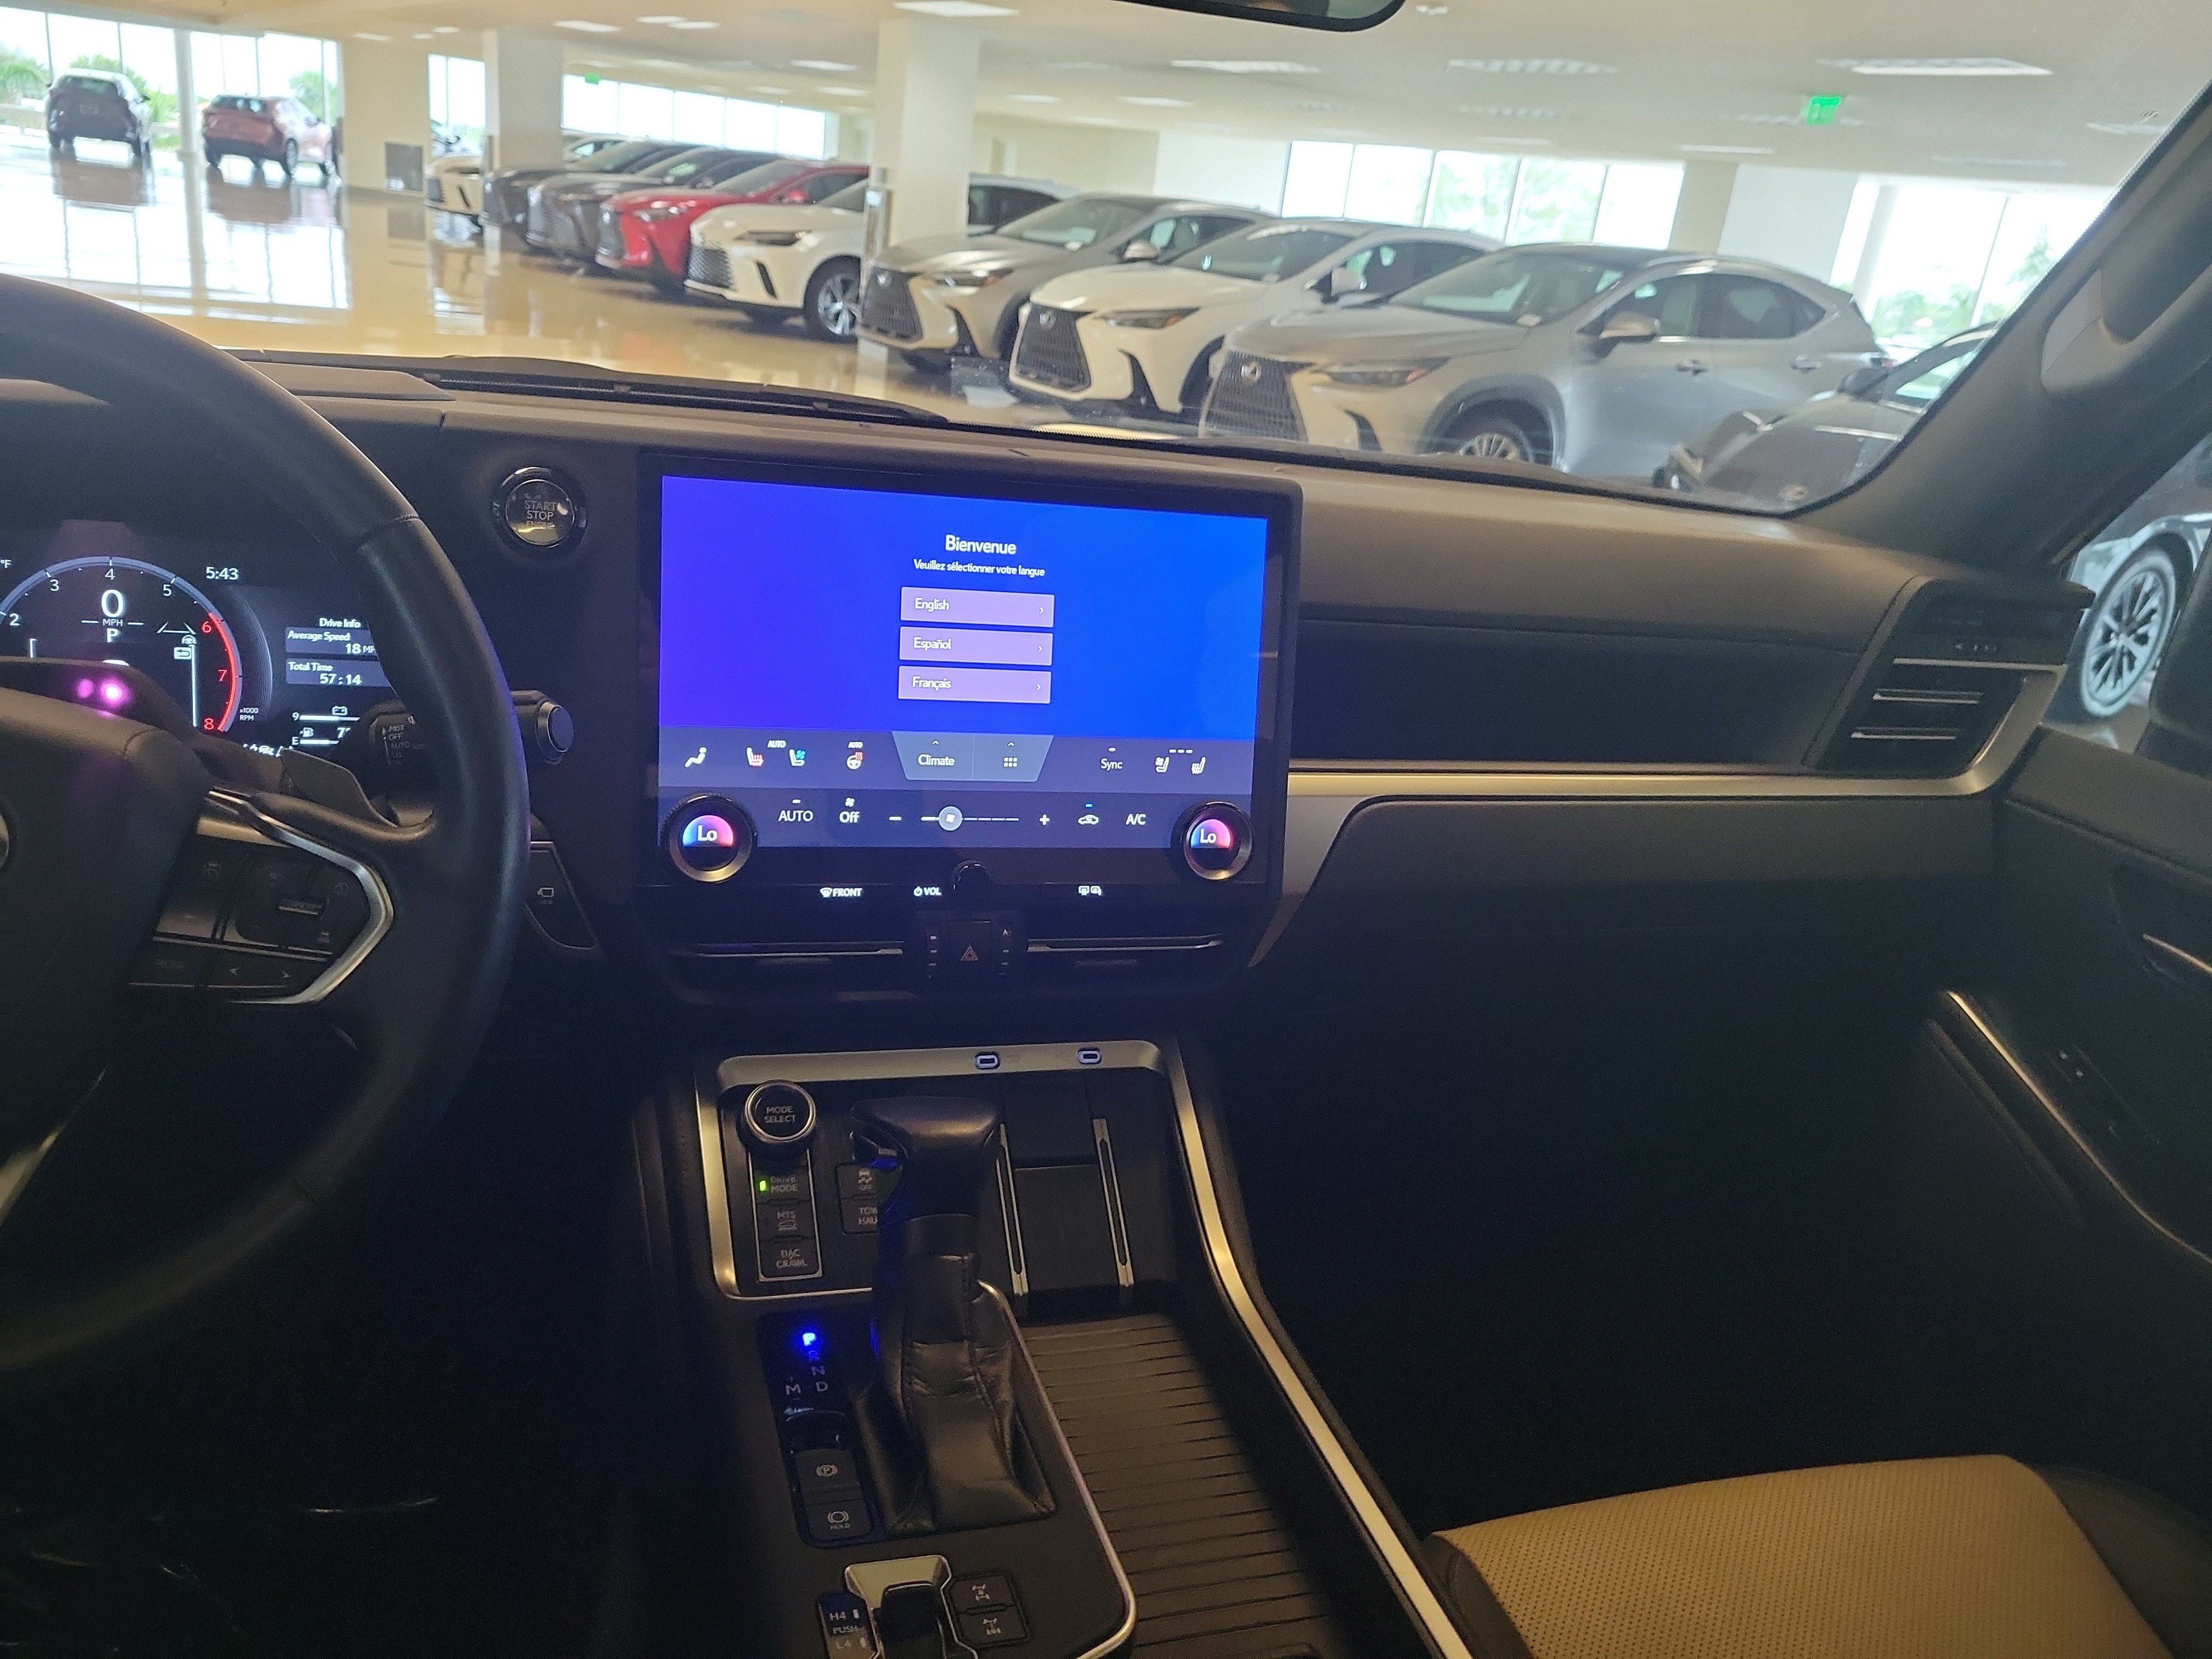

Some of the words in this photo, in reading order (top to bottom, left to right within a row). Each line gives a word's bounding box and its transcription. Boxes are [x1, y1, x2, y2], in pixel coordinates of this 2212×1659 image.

[524, 500, 557, 512] START
[526, 511, 554, 520] STOP
[945, 534, 1017, 555] Bienvenue
[104, 568, 116, 580] 4
[206, 566, 239, 580] 5:43
[913, 558, 945, 571] Veuillez
[946, 561, 995, 574] sélectionner
[996, 565, 1017, 574] votre
[1018, 565, 1045, 578] langue
[50, 579, 59, 591] 3
[162, 584, 172, 596] 5
[101, 589, 124, 618] 0
[915, 597, 950, 612] English
[9, 613, 20, 626] 2
[103, 618, 123, 627] MPH
[319, 617, 343, 628] Drive
[344, 619, 362, 629] Info
[202, 621, 212, 633] 6
[106, 628, 119, 643] P
[287, 630, 323, 642] Average
[324, 632, 351, 642] Speed
[345, 644, 361, 654] 18
[363, 645, 376, 653] MP
[913, 637, 952, 651] Español
[287, 662, 310, 671] Total
[311, 662, 334, 672] Time
[218, 669, 228, 682] 7
[912, 676, 952, 691] Français
[292, 712, 299, 721] 9
[204, 718, 214, 730] 8
[292, 736, 299, 745] E
[388, 732, 403, 741] OFF
[767, 740, 787, 748] AUTO
[918, 753, 956, 766] Climate
[1101, 758, 1123, 771] Sync
[778, 810, 814, 822] AUTO
[839, 811, 860, 823] Off
[1126, 814, 1146, 825] A/C
[697, 825, 718, 842] Lo
[1199, 828, 1216, 844] Lo
[832, 888, 862, 897] FRONT
[923, 887, 943, 896] VOL
[766, 1105, 794, 1114] MODE
[764, 1114, 795, 1123] SELECT
[770, 1184, 798, 1193] MODE
[777, 1211, 796, 1219] MTS
[859, 1216, 878, 1226] HAU
[781, 1249, 800, 1258] DAC
[802, 1333, 817, 1346] P
[811, 1365, 825, 1375] N
[785, 1384, 801, 1395] M
[816, 1381, 828, 1392] D
[829, 1611, 847, 1621] H4
